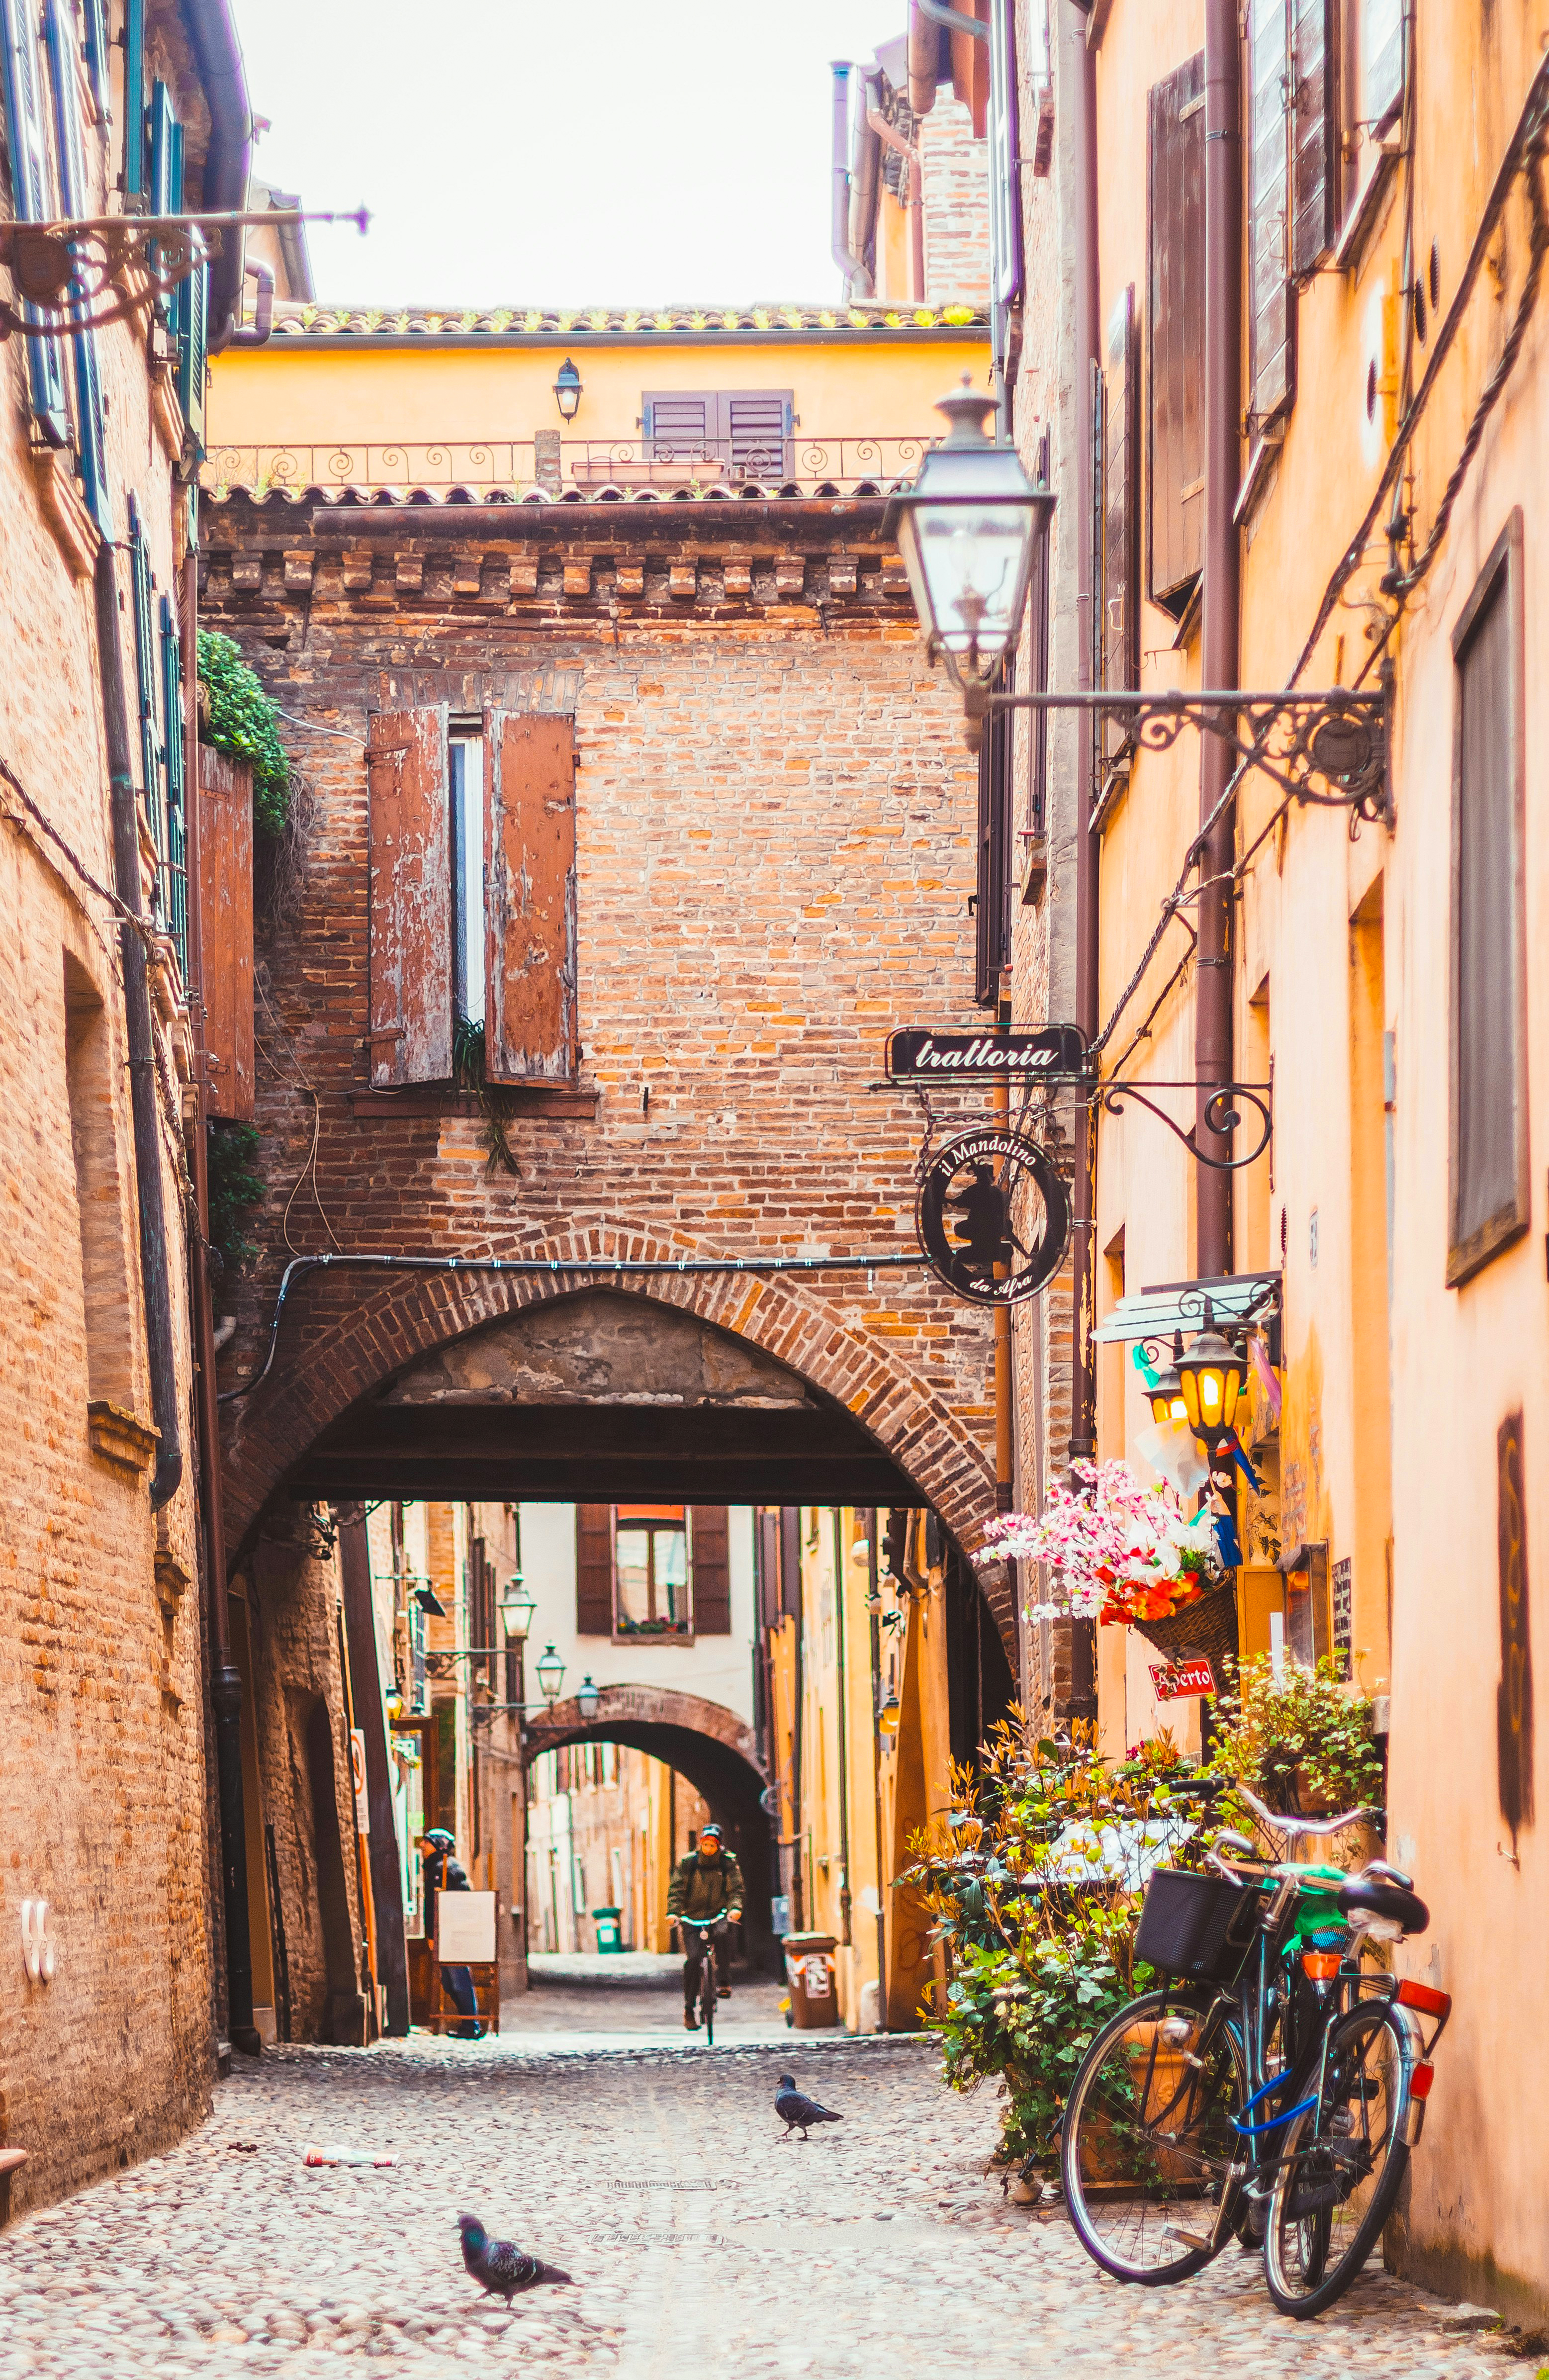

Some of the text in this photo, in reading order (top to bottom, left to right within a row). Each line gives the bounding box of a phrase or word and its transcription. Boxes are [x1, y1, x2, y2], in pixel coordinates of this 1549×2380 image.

[915, 1039, 1059, 1067] trattoria
[938, 1135, 1036, 1177] il Mandolino
[969, 1275, 1033, 1298] da Afra
